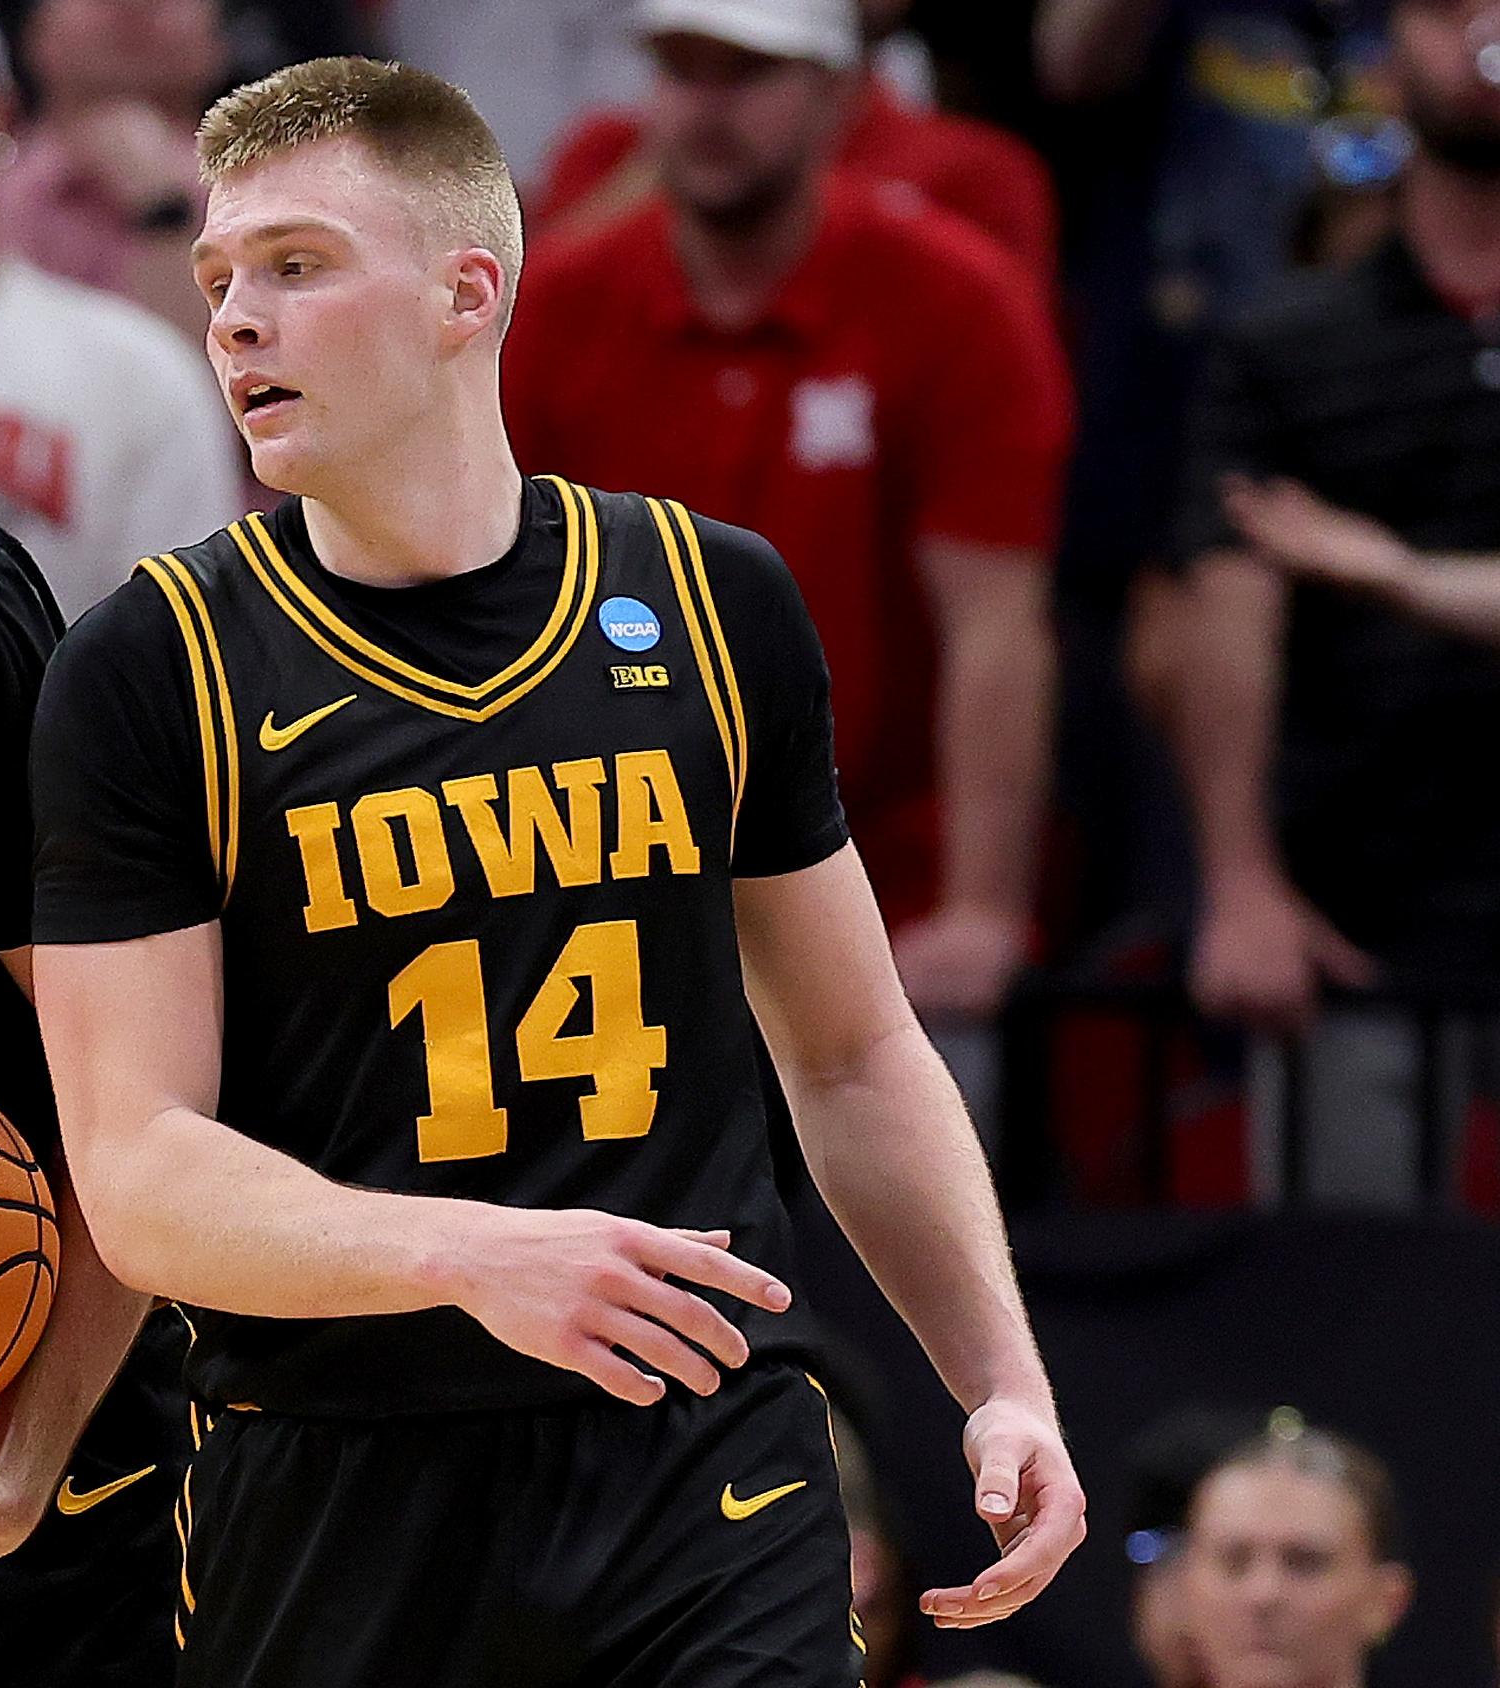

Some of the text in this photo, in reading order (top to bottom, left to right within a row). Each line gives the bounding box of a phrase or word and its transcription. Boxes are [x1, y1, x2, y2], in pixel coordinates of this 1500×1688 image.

[608, 622, 658, 638] NCAA
[285, 749, 700, 934] IOWA
[388, 919, 666, 1163] 14
